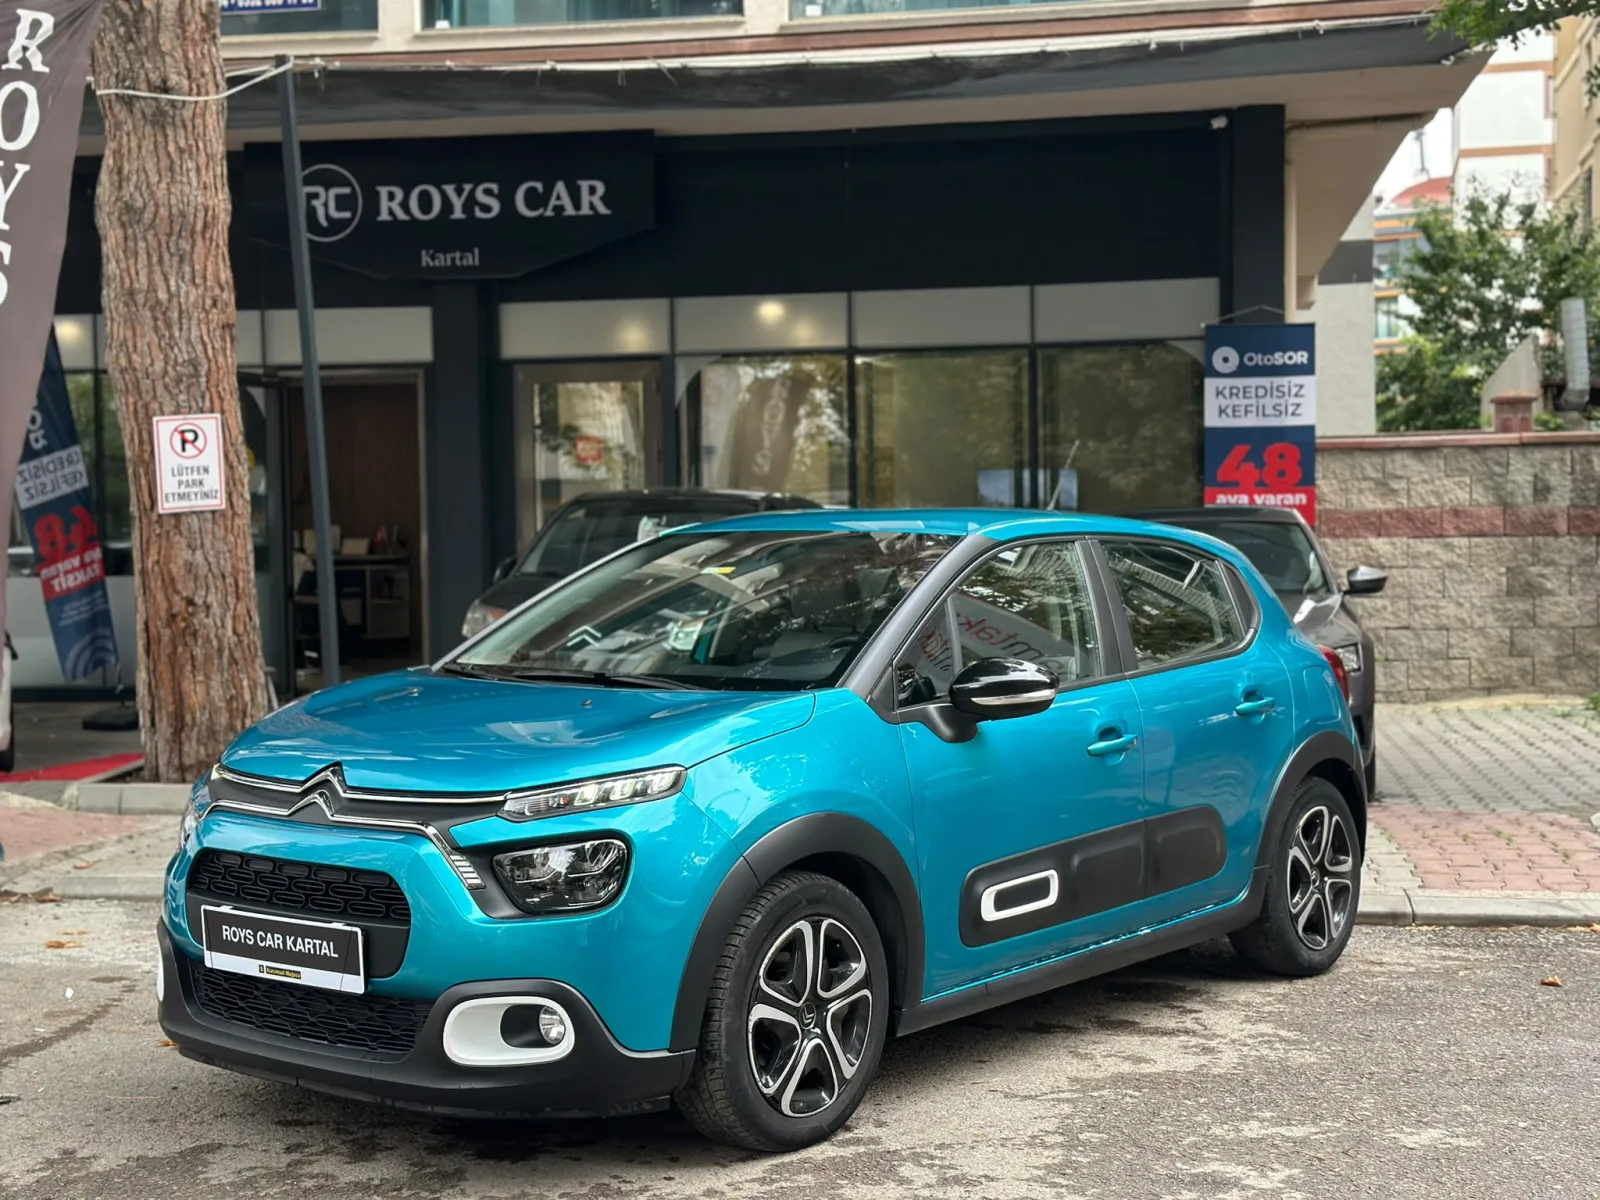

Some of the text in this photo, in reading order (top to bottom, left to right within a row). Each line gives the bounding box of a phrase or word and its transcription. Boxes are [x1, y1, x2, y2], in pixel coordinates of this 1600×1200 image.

[375, 179, 612, 221] ROYS CAR
[420, 248, 480, 268] Kartal
[1243, 351, 1309, 366] OtoSOR
[1215, 381, 1306, 400] KREDİSİZ
[1217, 401, 1303, 419] KEFİLSİZ
[171, 463, 210, 478] LÜTFEN
[1216, 442, 1303, 490] 48
[177, 478, 205, 490] PARK
[165, 487, 219, 503] ETMEYİNİZ
[1253, 492, 1308, 506] varan
[221, 925, 339, 957] ROYS CAR KARTAL
